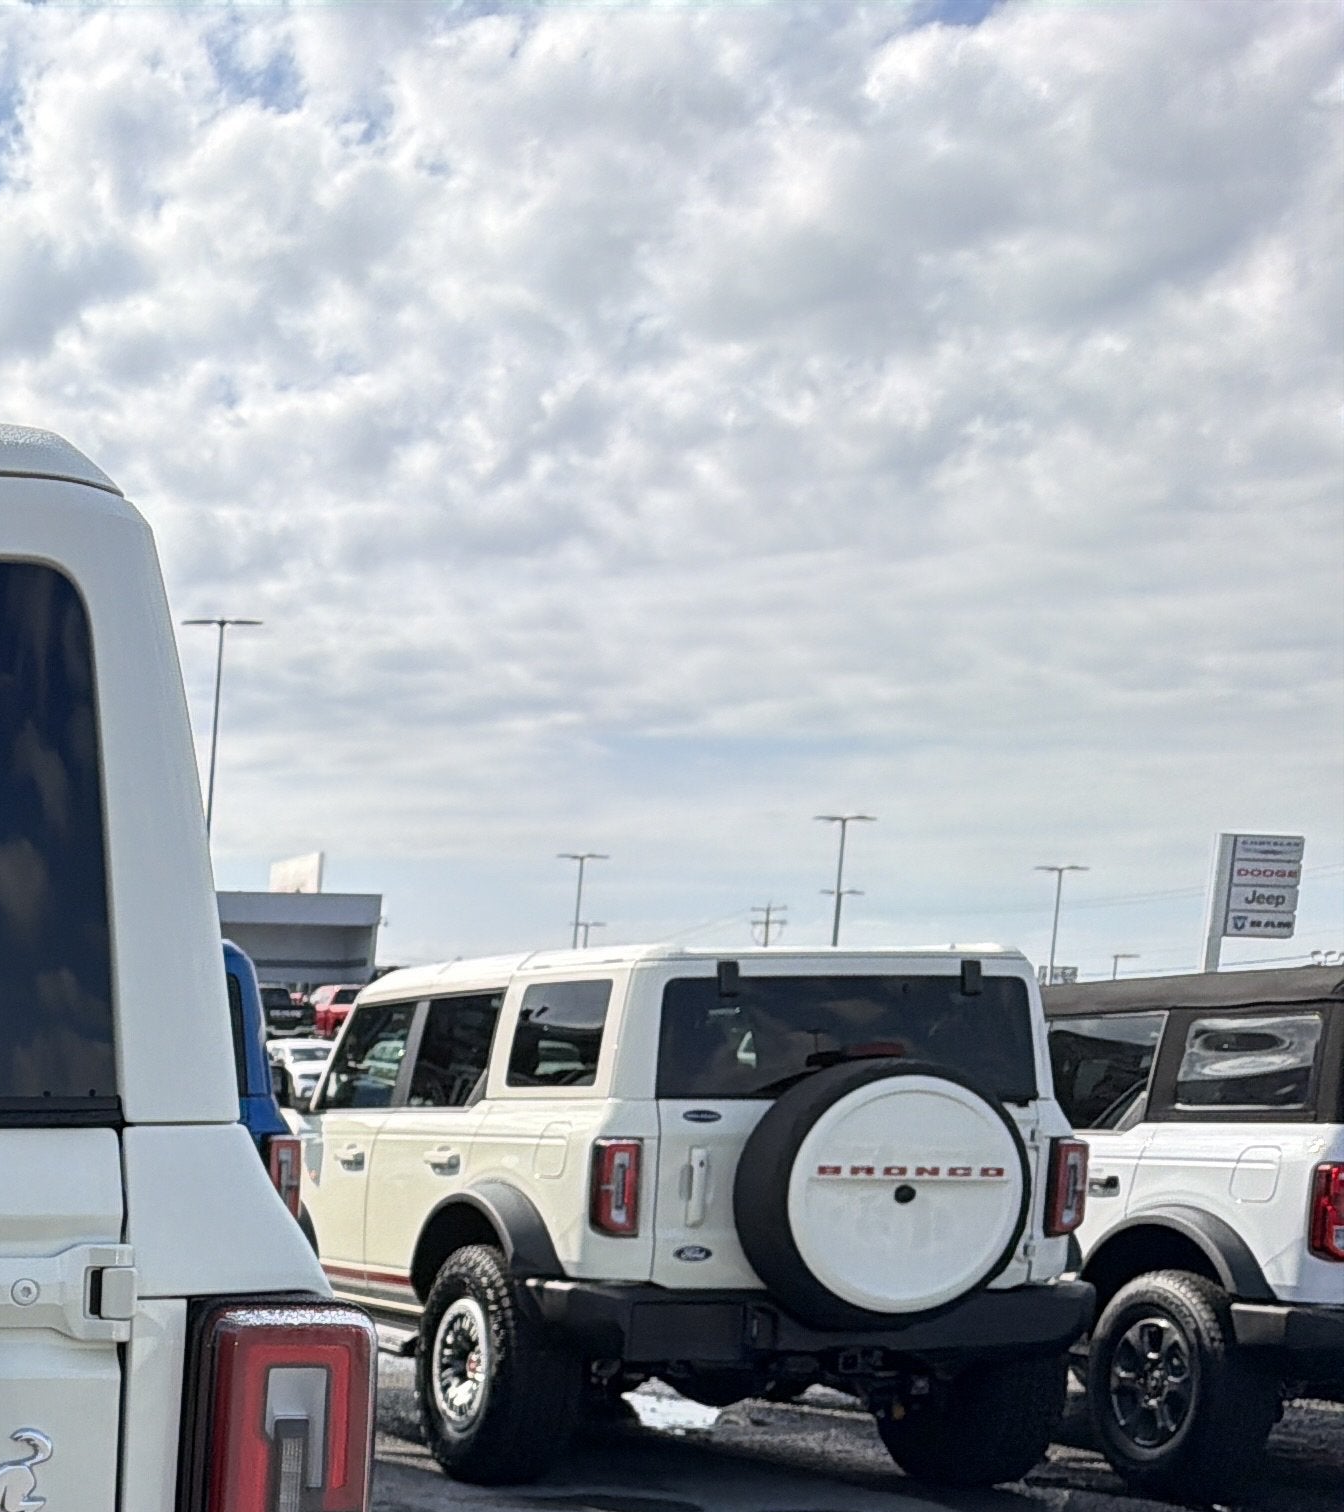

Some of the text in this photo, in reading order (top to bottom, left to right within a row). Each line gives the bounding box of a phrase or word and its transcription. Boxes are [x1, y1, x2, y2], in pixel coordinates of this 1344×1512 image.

[1237, 868, 1297, 878] DODGE
[1244, 889, 1286, 907] Jeep
[817, 1165, 1004, 1177] BRONCO
